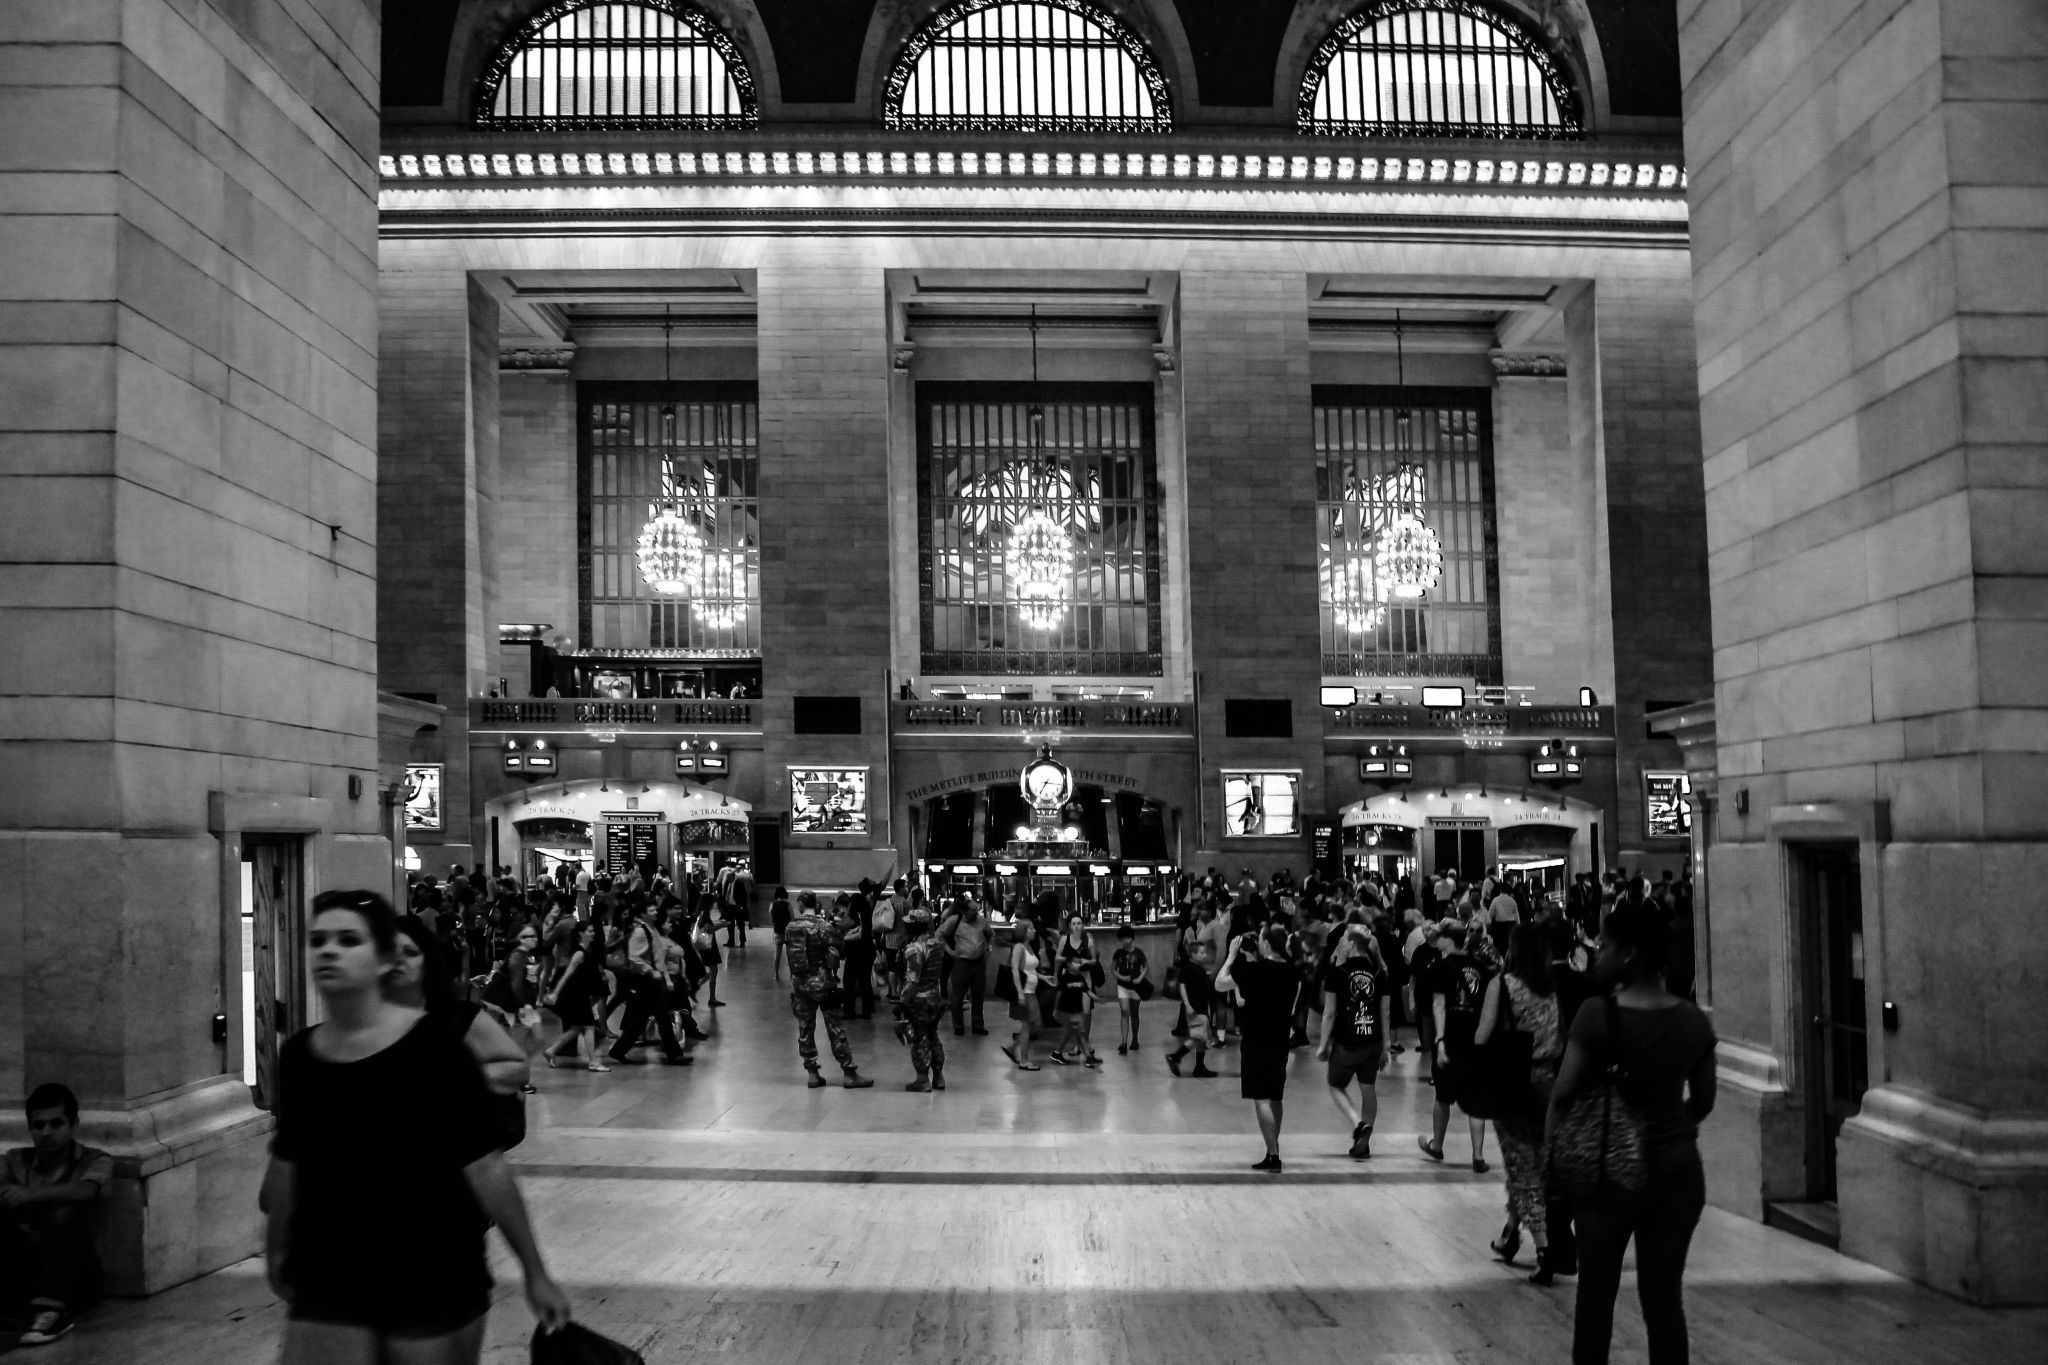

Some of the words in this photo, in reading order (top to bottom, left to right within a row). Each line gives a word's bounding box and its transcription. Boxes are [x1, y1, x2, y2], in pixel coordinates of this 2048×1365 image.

[906, 786, 929, 800] THE
[930, 774, 974, 792] METLIFE
[977, 769, 1021, 782] BUILDIN
[1097, 773, 1138, 787] STREET
[539, 806, 565, 814] TRACK
[700, 808, 731, 816] TRACKS
[1361, 811, 1393, 820] TRACKS
